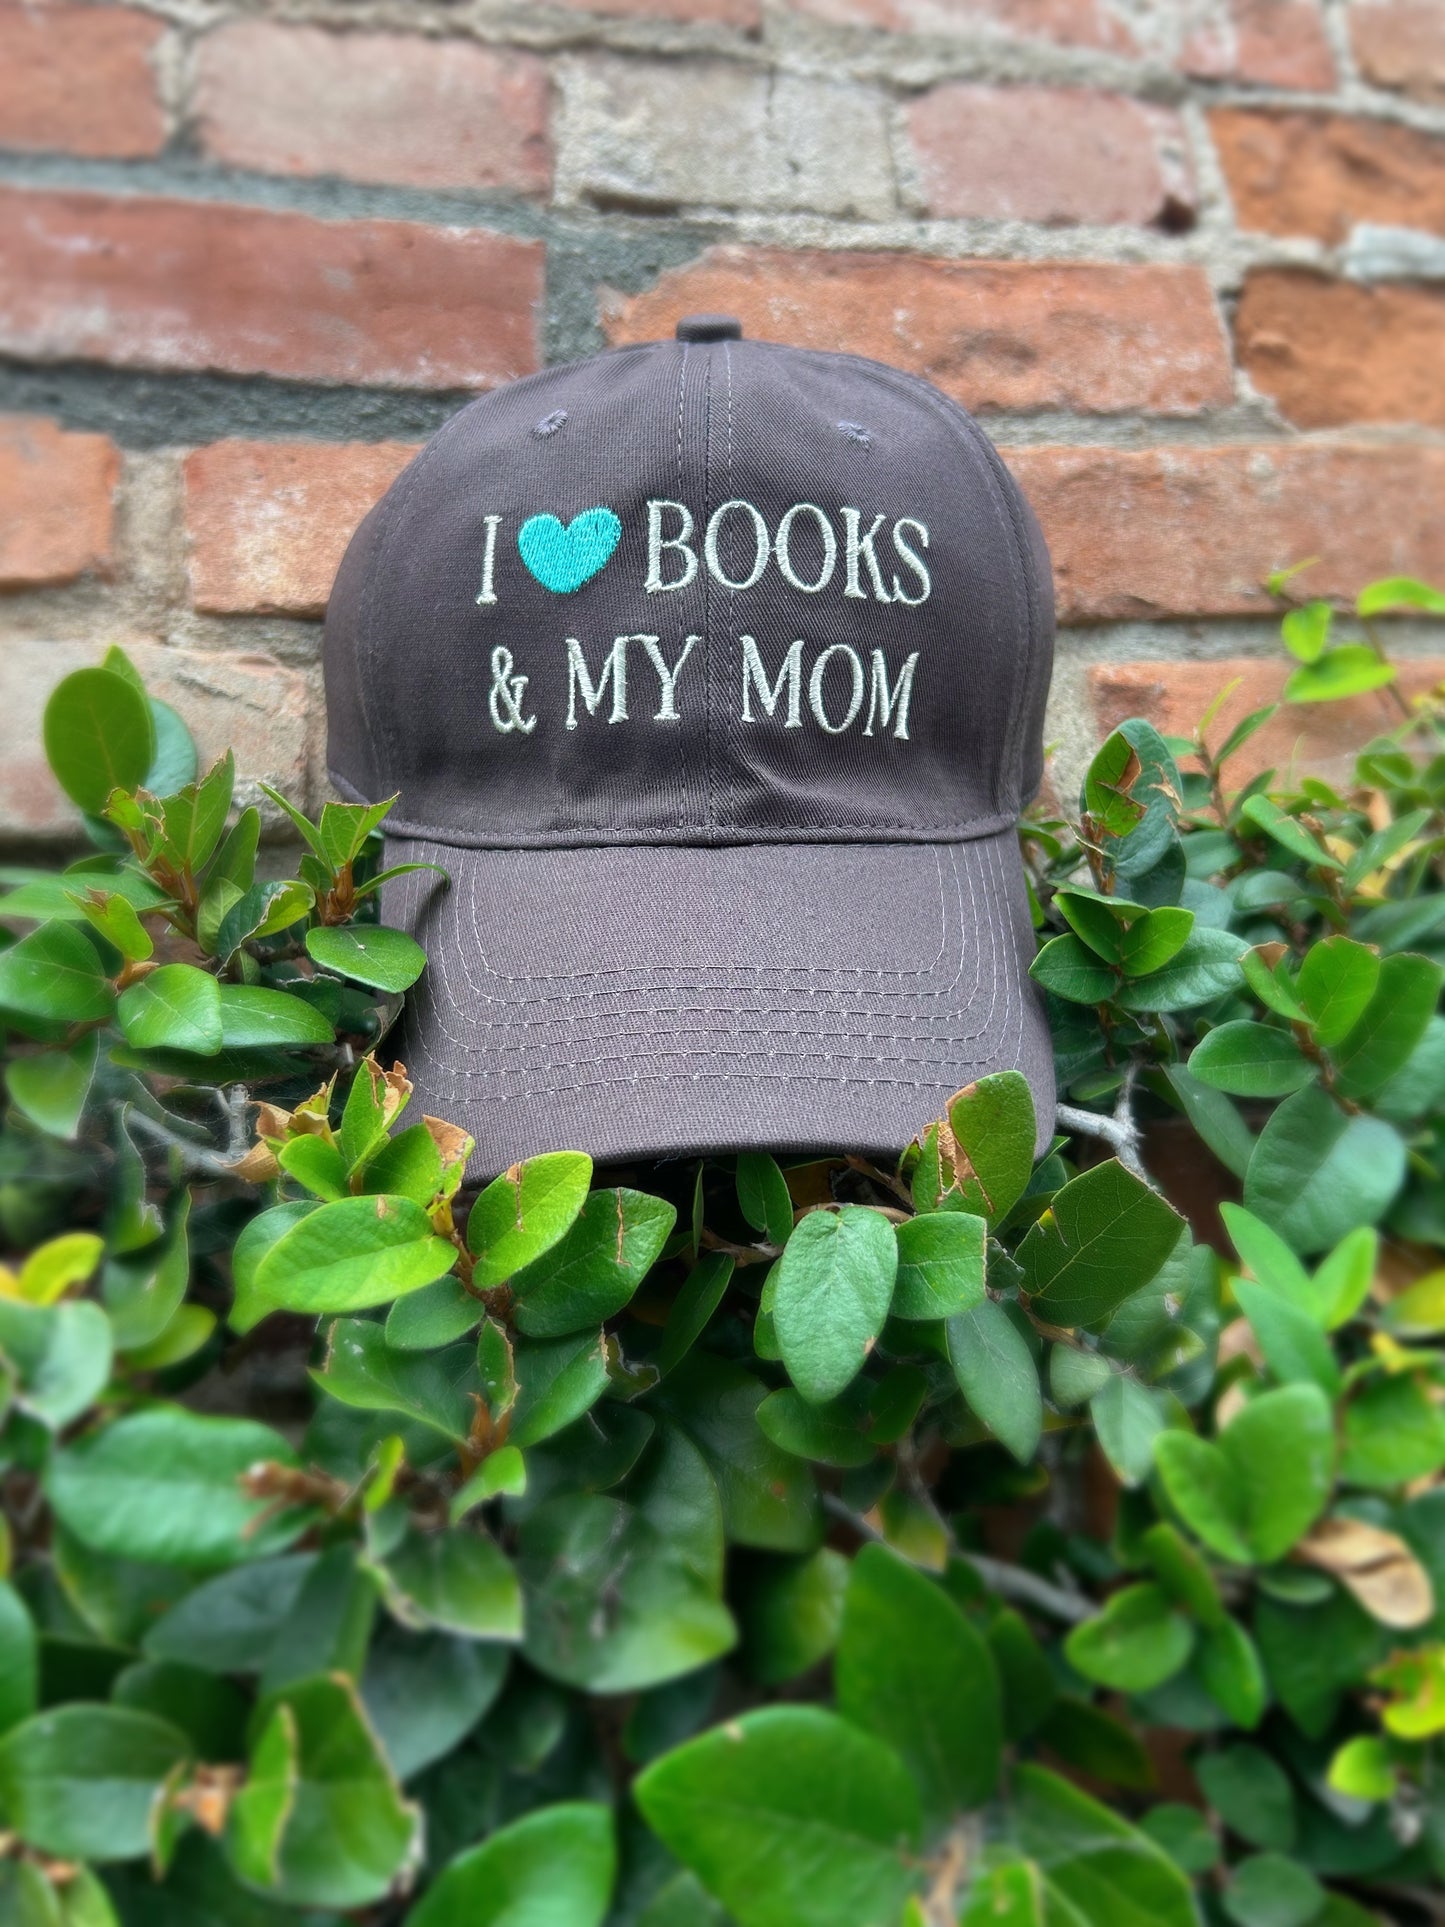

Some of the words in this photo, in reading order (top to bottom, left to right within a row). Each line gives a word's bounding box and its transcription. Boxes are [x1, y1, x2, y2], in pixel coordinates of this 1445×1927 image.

[475, 514, 503, 605] I
[644, 500, 931, 606] BOOKS
[489, 646, 537, 734] &
[565, 634, 702, 731] MY
[739, 635, 920, 740] MOM
